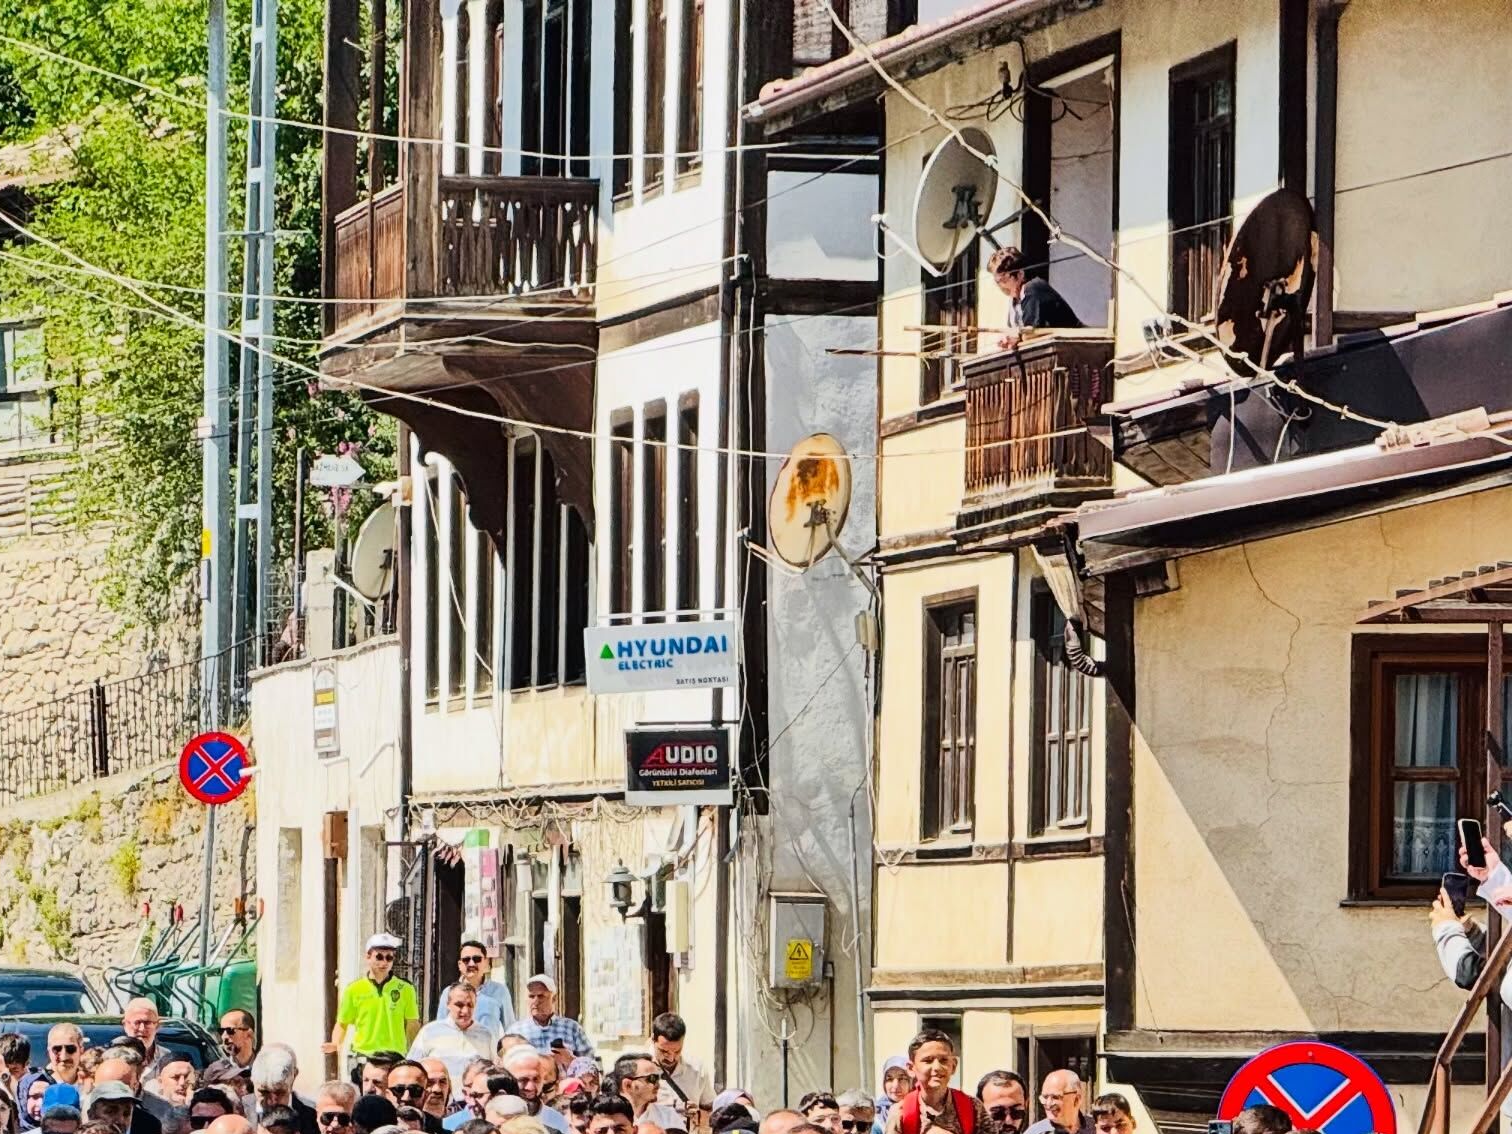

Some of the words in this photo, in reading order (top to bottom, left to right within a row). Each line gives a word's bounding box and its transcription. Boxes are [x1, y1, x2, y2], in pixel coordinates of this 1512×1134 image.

[617, 635, 727, 658] HYUNDAI
[644, 745, 718, 764] AUDIO
[638, 768, 678, 777] Görüntülü
